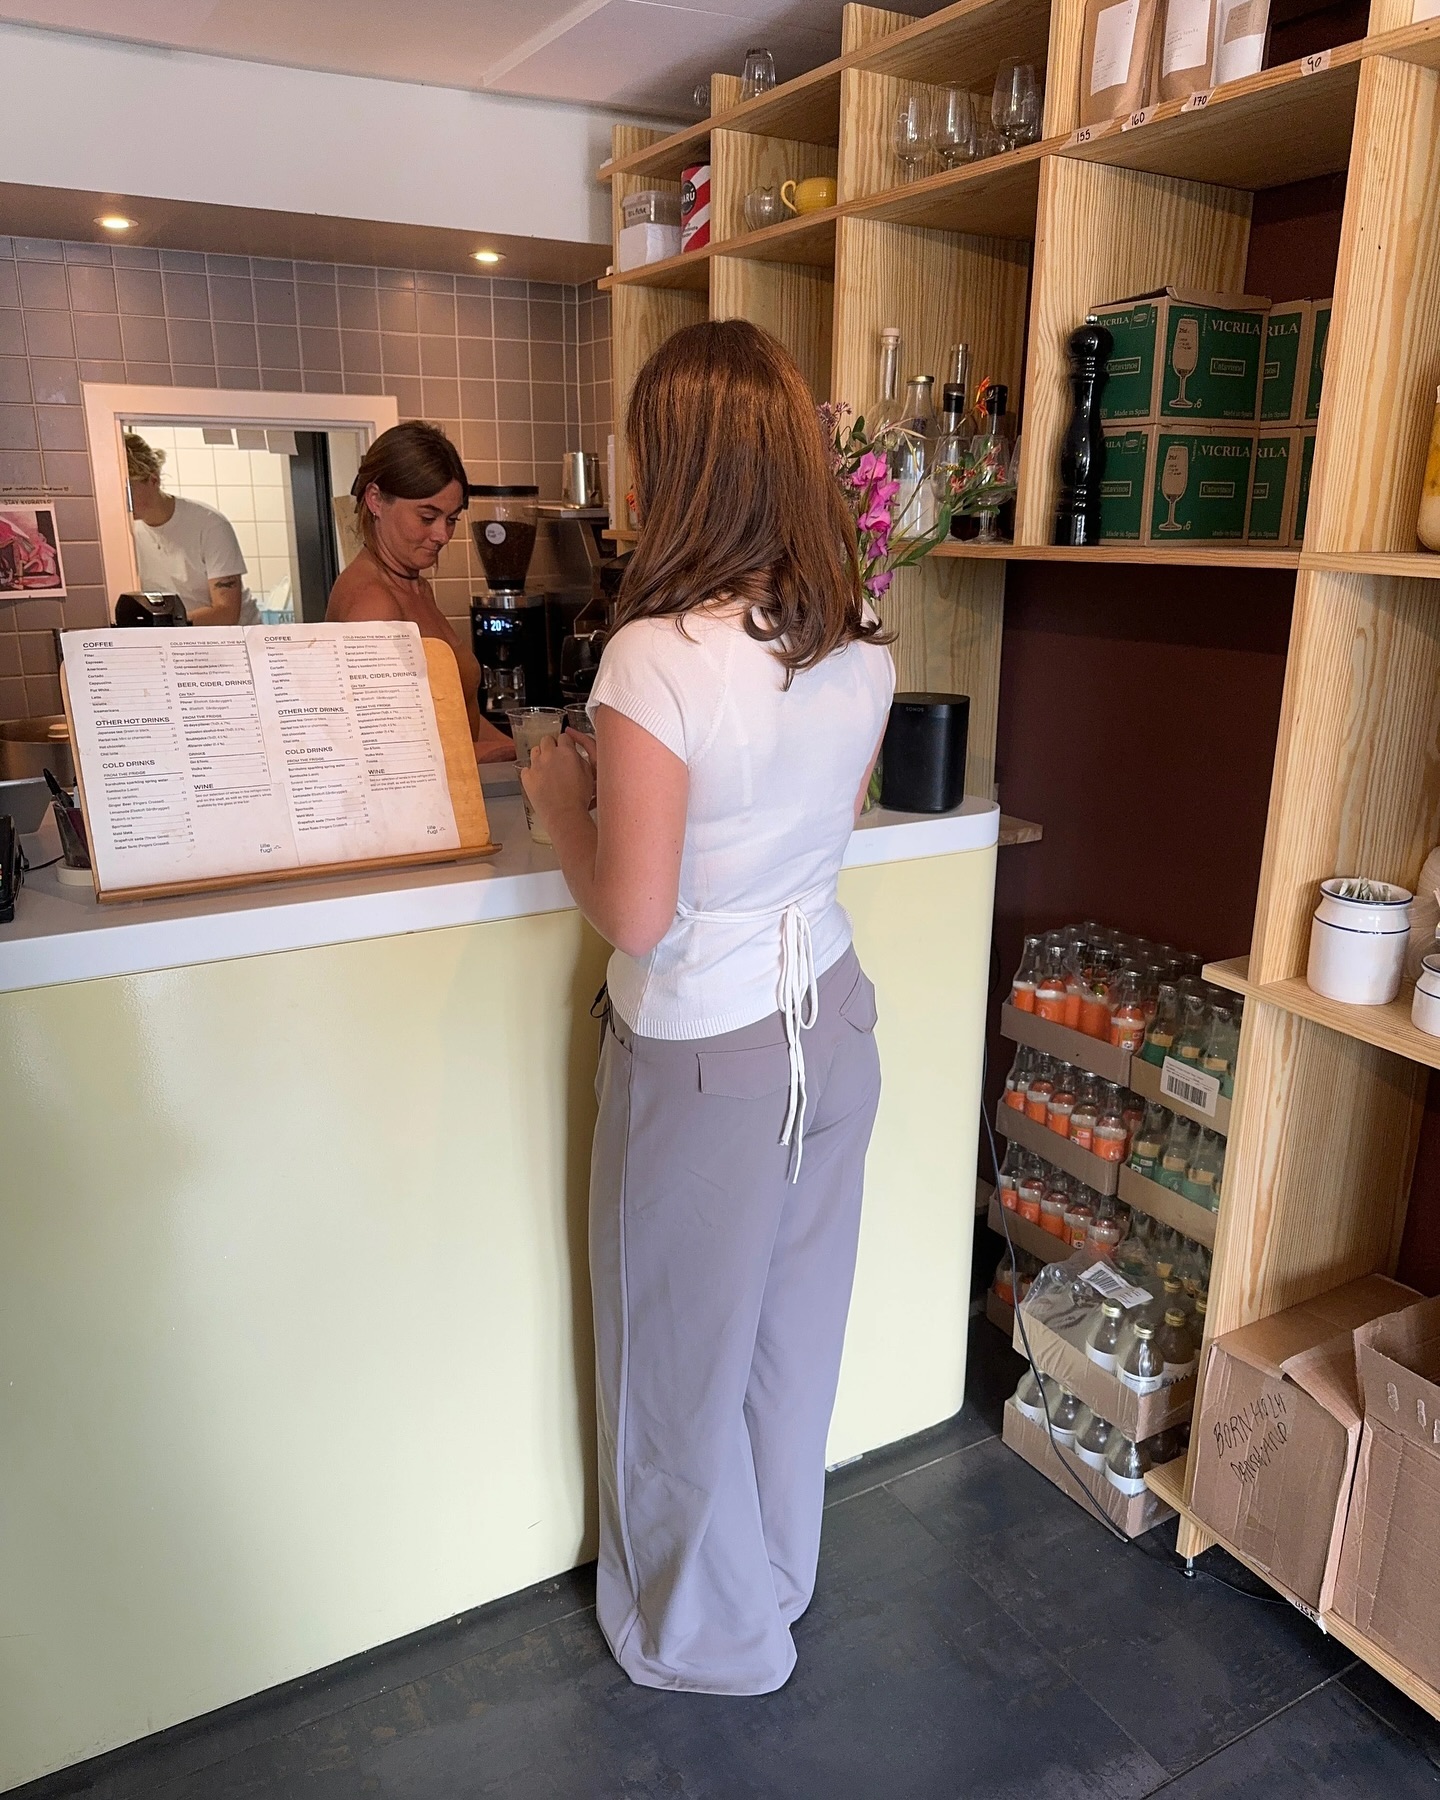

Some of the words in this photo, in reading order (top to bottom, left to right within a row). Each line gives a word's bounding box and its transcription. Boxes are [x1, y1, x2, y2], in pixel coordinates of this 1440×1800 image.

[1308, 56, 1322, 72] 90
[1193, 96, 1207, 106] 170
[1132, 112, 1145, 126] 160
[1076, 130, 1091, 142] 155
[1212, 320, 1260, 335] VICRILA
[1106, 362, 1138, 372] Catavinos
[1202, 444, 1249, 457] VICRILA
